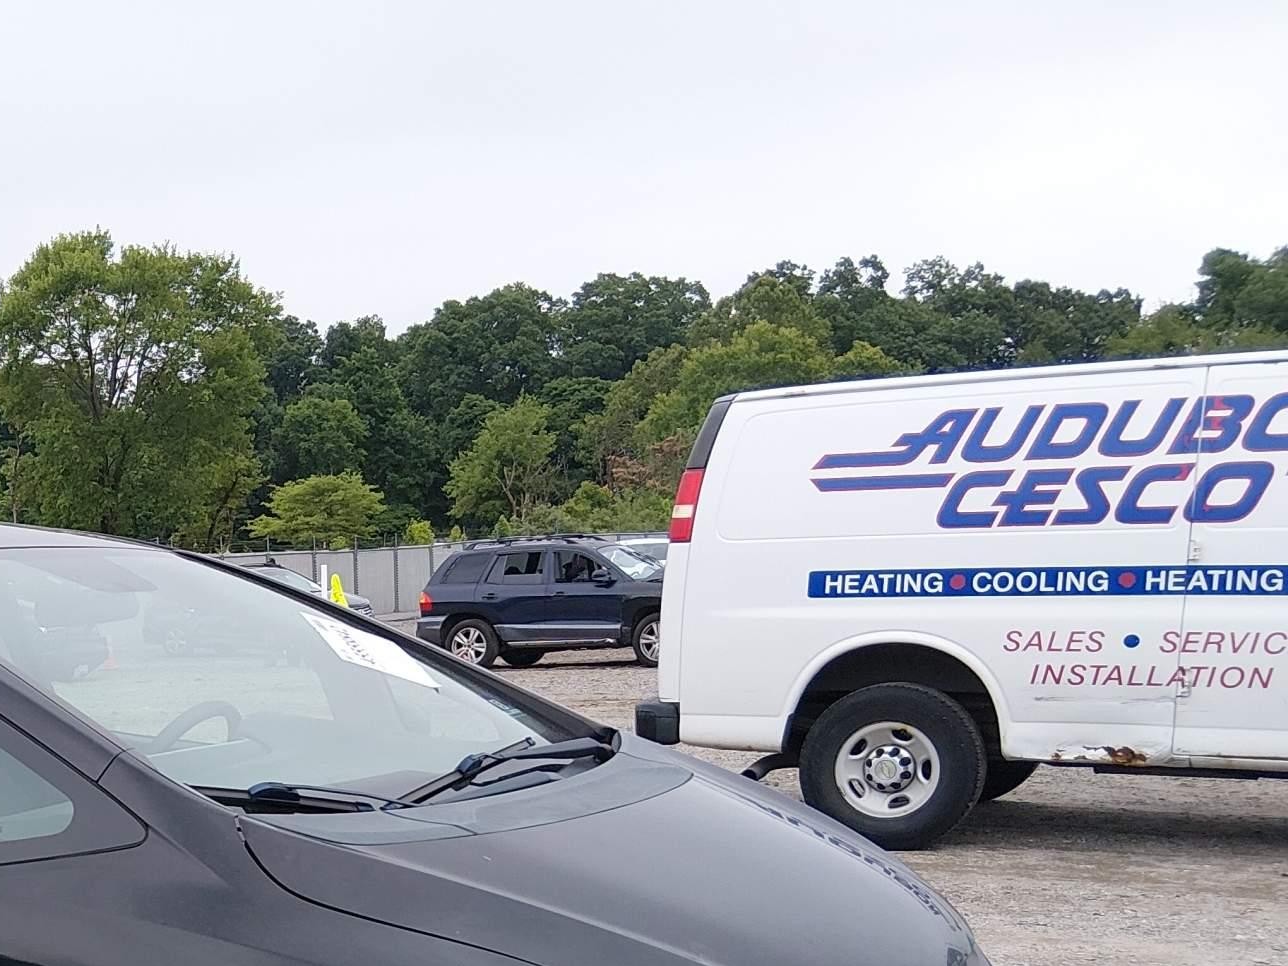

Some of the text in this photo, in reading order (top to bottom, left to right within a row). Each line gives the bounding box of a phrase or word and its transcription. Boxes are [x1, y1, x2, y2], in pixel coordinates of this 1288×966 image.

[935, 460, 1275, 528] CESCO
[824, 569, 1284, 594] HEATING COOLING HEATING
[1002, 630, 1288, 655] SALES SERVIC
[1029, 664, 1274, 689] INSTALLATION
